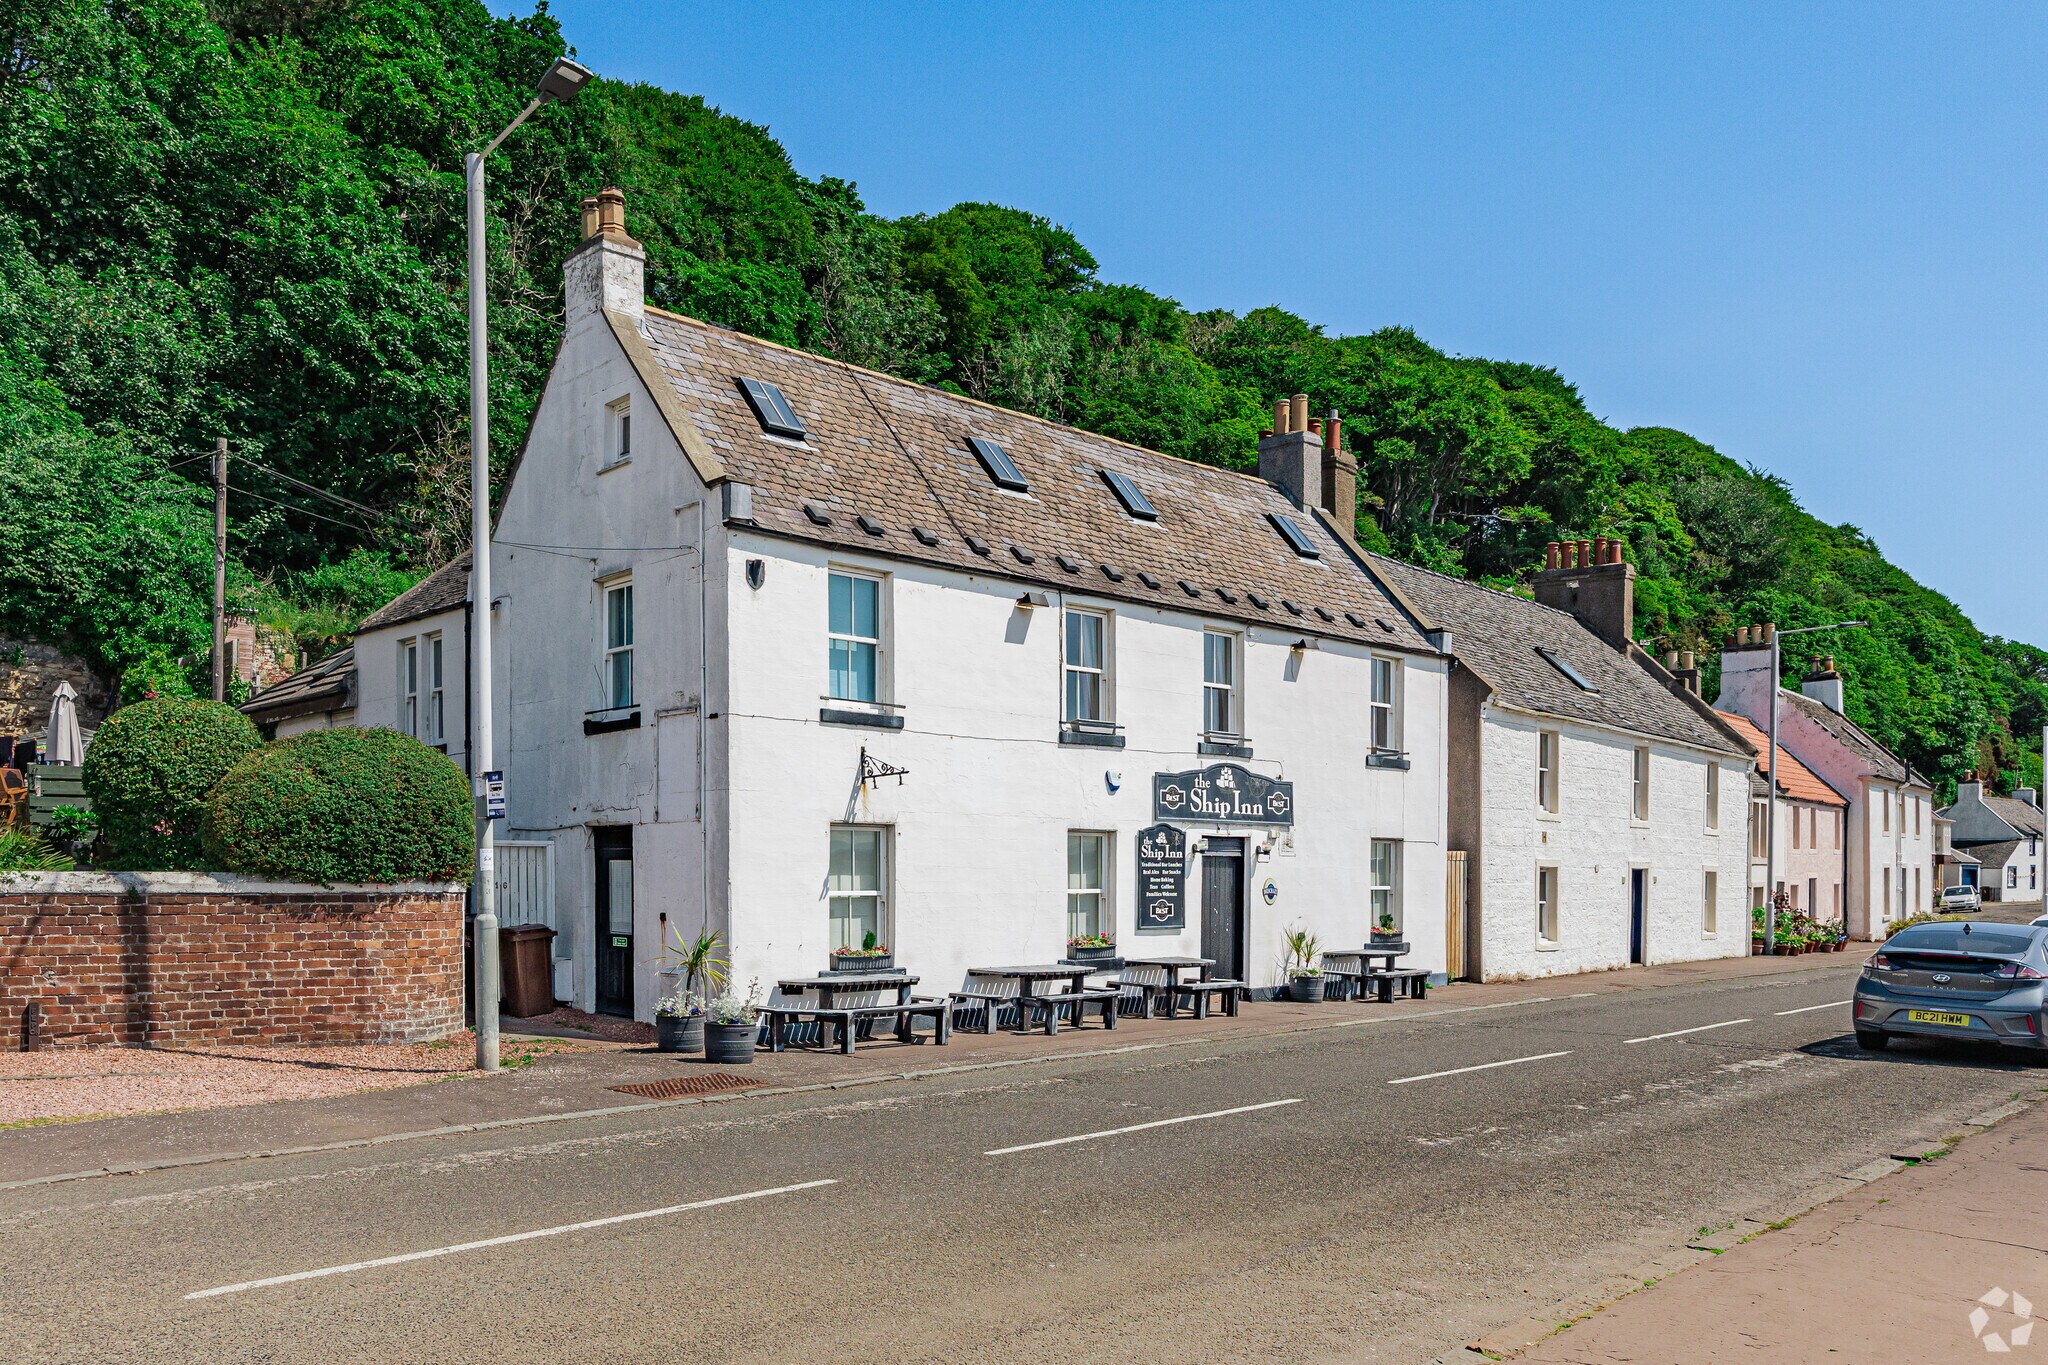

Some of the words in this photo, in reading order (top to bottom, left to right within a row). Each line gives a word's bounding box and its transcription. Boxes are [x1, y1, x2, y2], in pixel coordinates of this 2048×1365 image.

[1194, 773, 1211, 788] the
[1190, 788, 1231, 819] Ship
[1232, 790, 1264, 816] Inn
[1144, 836, 1152, 845] the
[1141, 844, 1164, 860] Ship
[1165, 845, 1183, 858] Inn
[1915, 1012, 1938, 1022] BC21
[1940, 1014, 1963, 1024] HWM
